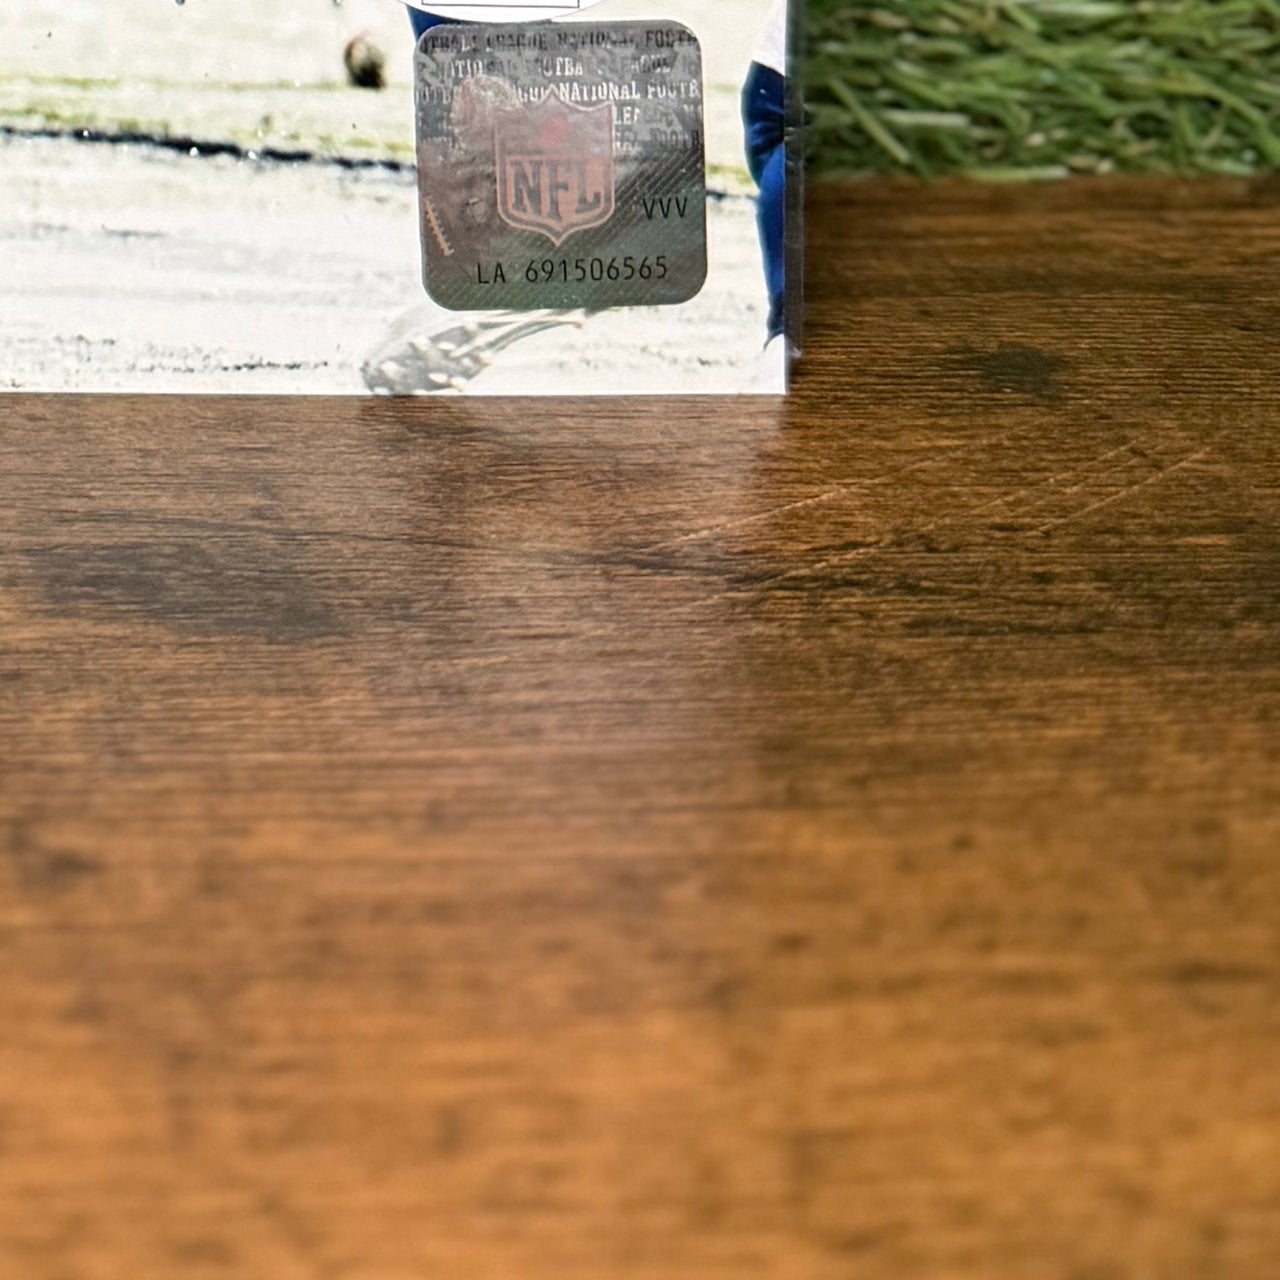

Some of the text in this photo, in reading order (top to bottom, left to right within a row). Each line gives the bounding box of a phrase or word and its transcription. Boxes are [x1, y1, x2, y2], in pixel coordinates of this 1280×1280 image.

[559, 81, 641, 103] NATIONAL
[509, 158, 602, 223] NFL
[642, 196, 689, 220] VVV
[477, 255, 668, 285] LA 691506565
